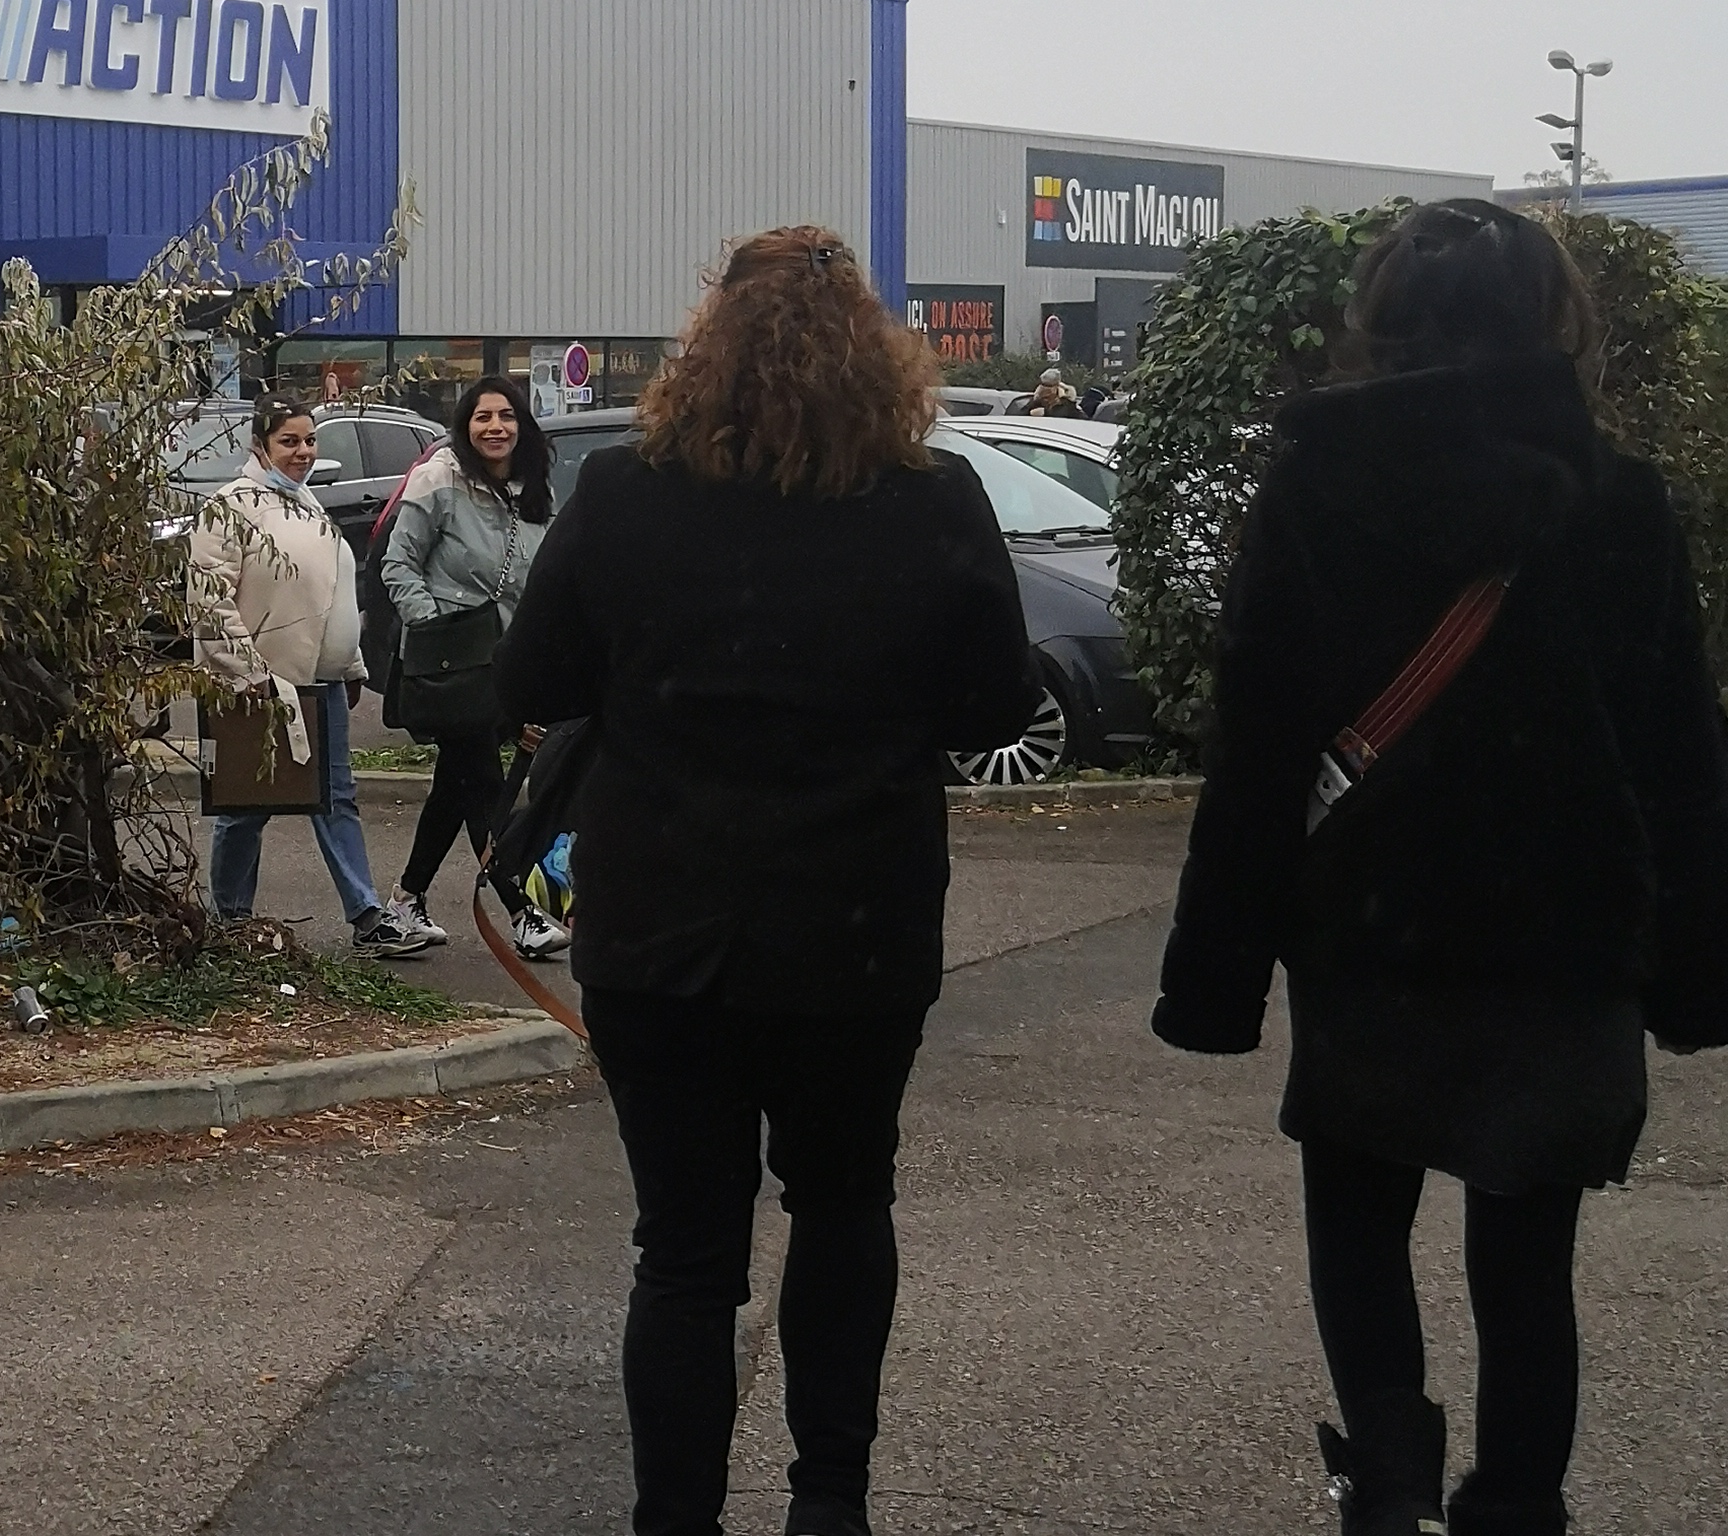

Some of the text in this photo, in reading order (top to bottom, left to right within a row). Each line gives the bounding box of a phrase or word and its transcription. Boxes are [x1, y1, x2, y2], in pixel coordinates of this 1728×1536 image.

[1065, 178, 1130, 245] SAINT
[907, 299, 994, 333] ICI, ON ASSURE
